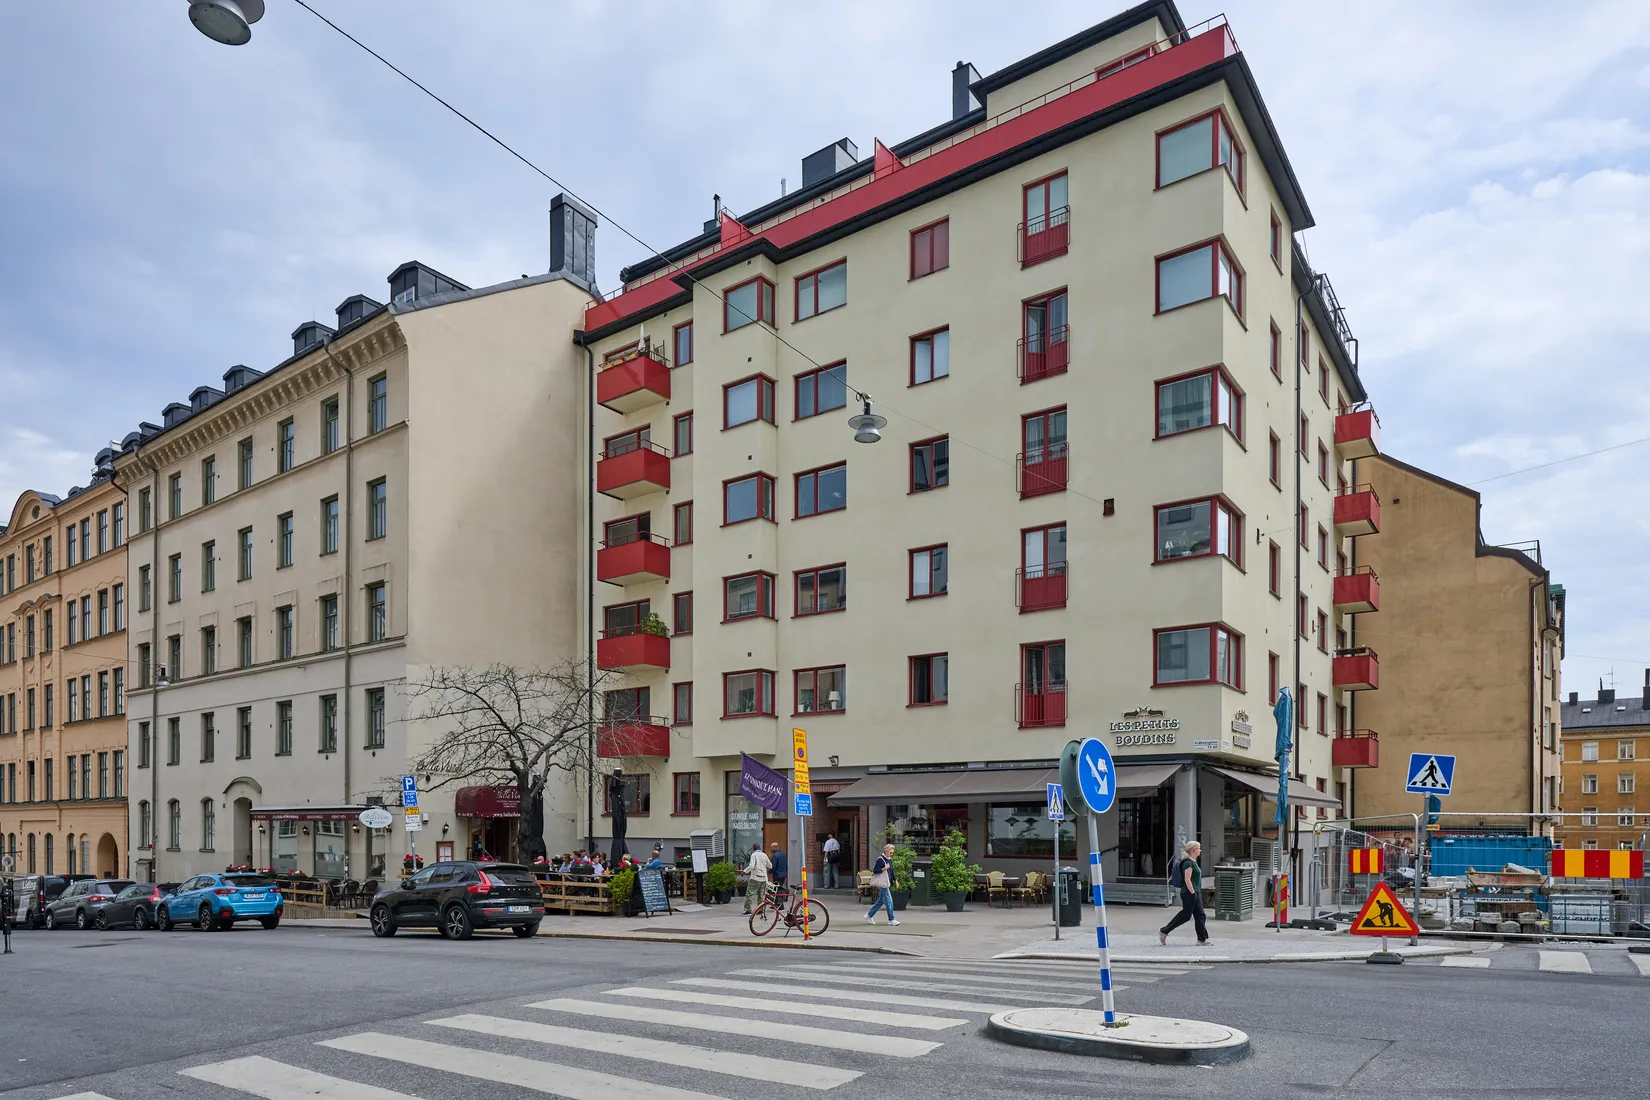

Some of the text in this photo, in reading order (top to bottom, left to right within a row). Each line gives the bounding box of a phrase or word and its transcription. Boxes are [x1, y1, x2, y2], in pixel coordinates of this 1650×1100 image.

[1110, 719, 1180, 732] LES PETITS
[1116, 734, 1176, 747] BOUDINS
[405, 777, 413, 790] P
